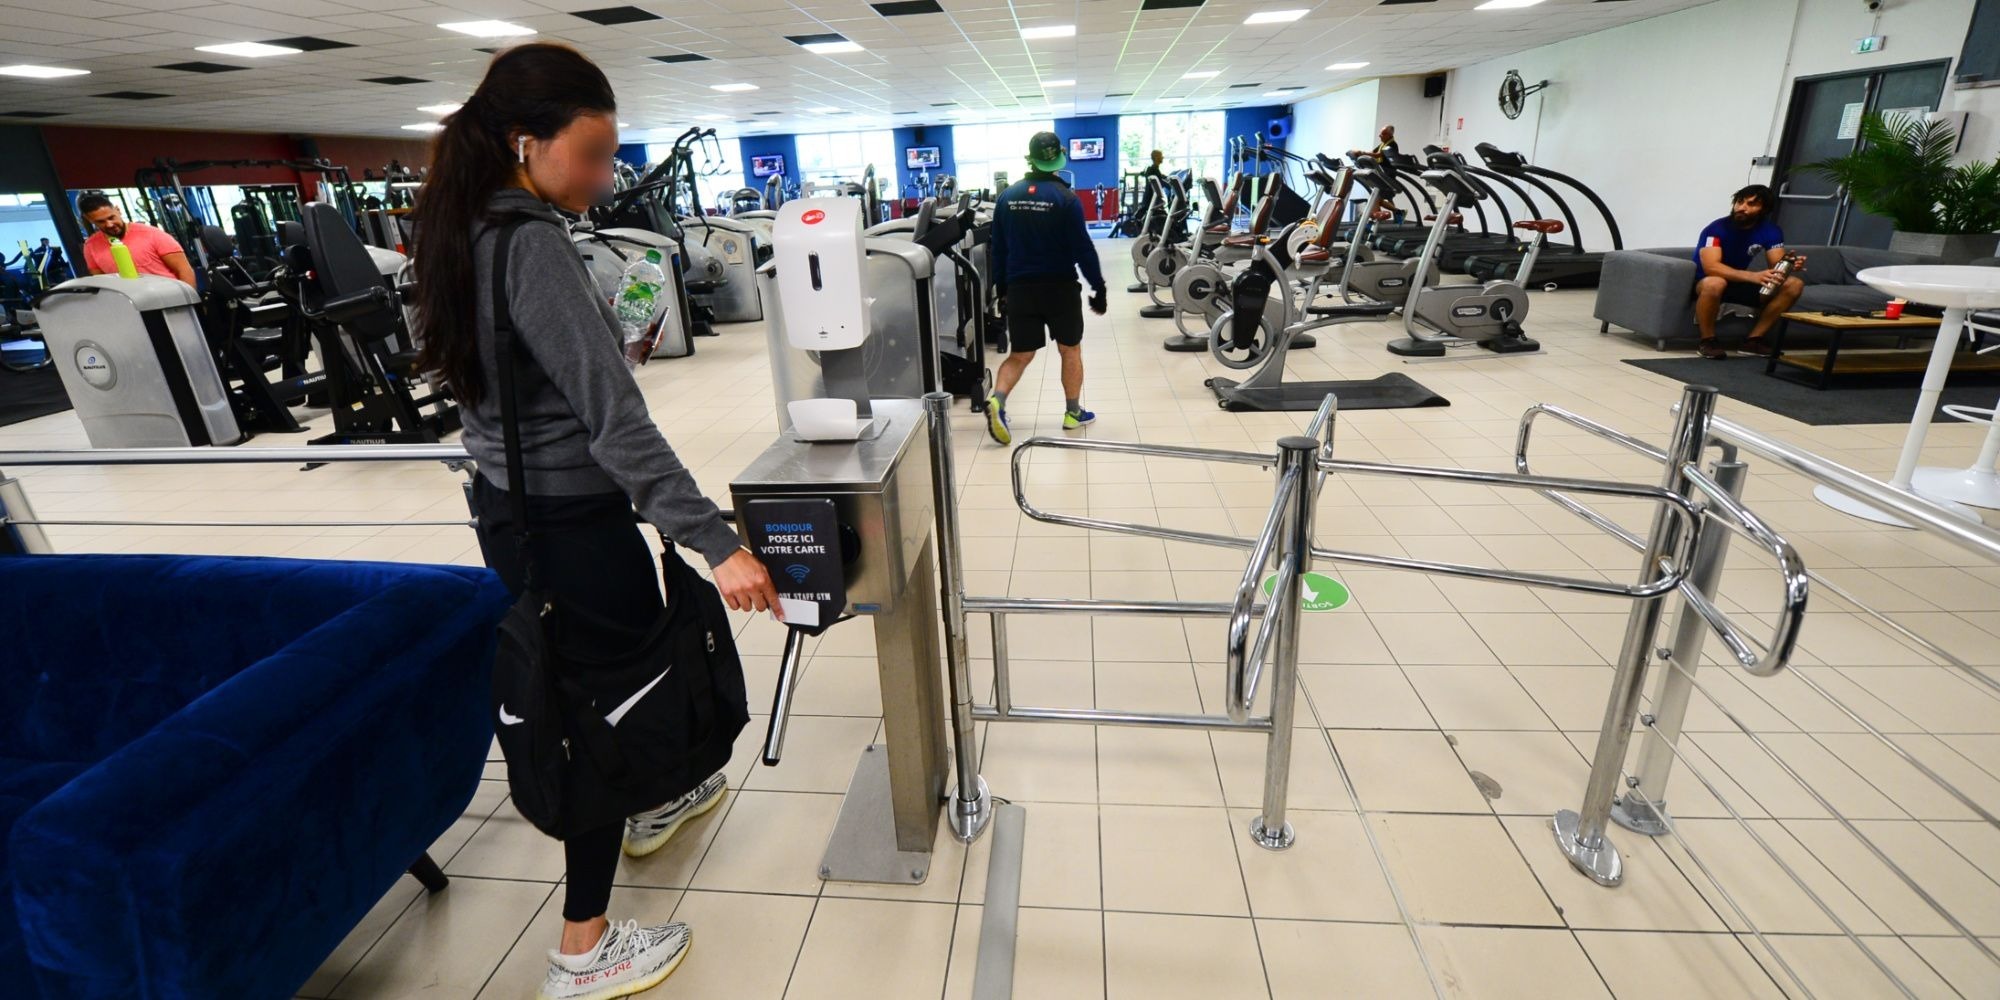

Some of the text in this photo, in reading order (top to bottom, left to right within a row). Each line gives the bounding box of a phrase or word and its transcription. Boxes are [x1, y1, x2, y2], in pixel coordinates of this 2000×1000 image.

[303, 374, 327, 385] NAUTILU
[765, 523, 813, 533] BONJOUR
[768, 535, 814, 543] POSEZ ICI
[760, 545, 826, 554] VOTRE CARTE
[778, 592, 792, 600] ODY
[816, 592, 832, 601] GYM
[1302, 601, 1334, 609] SORTI
